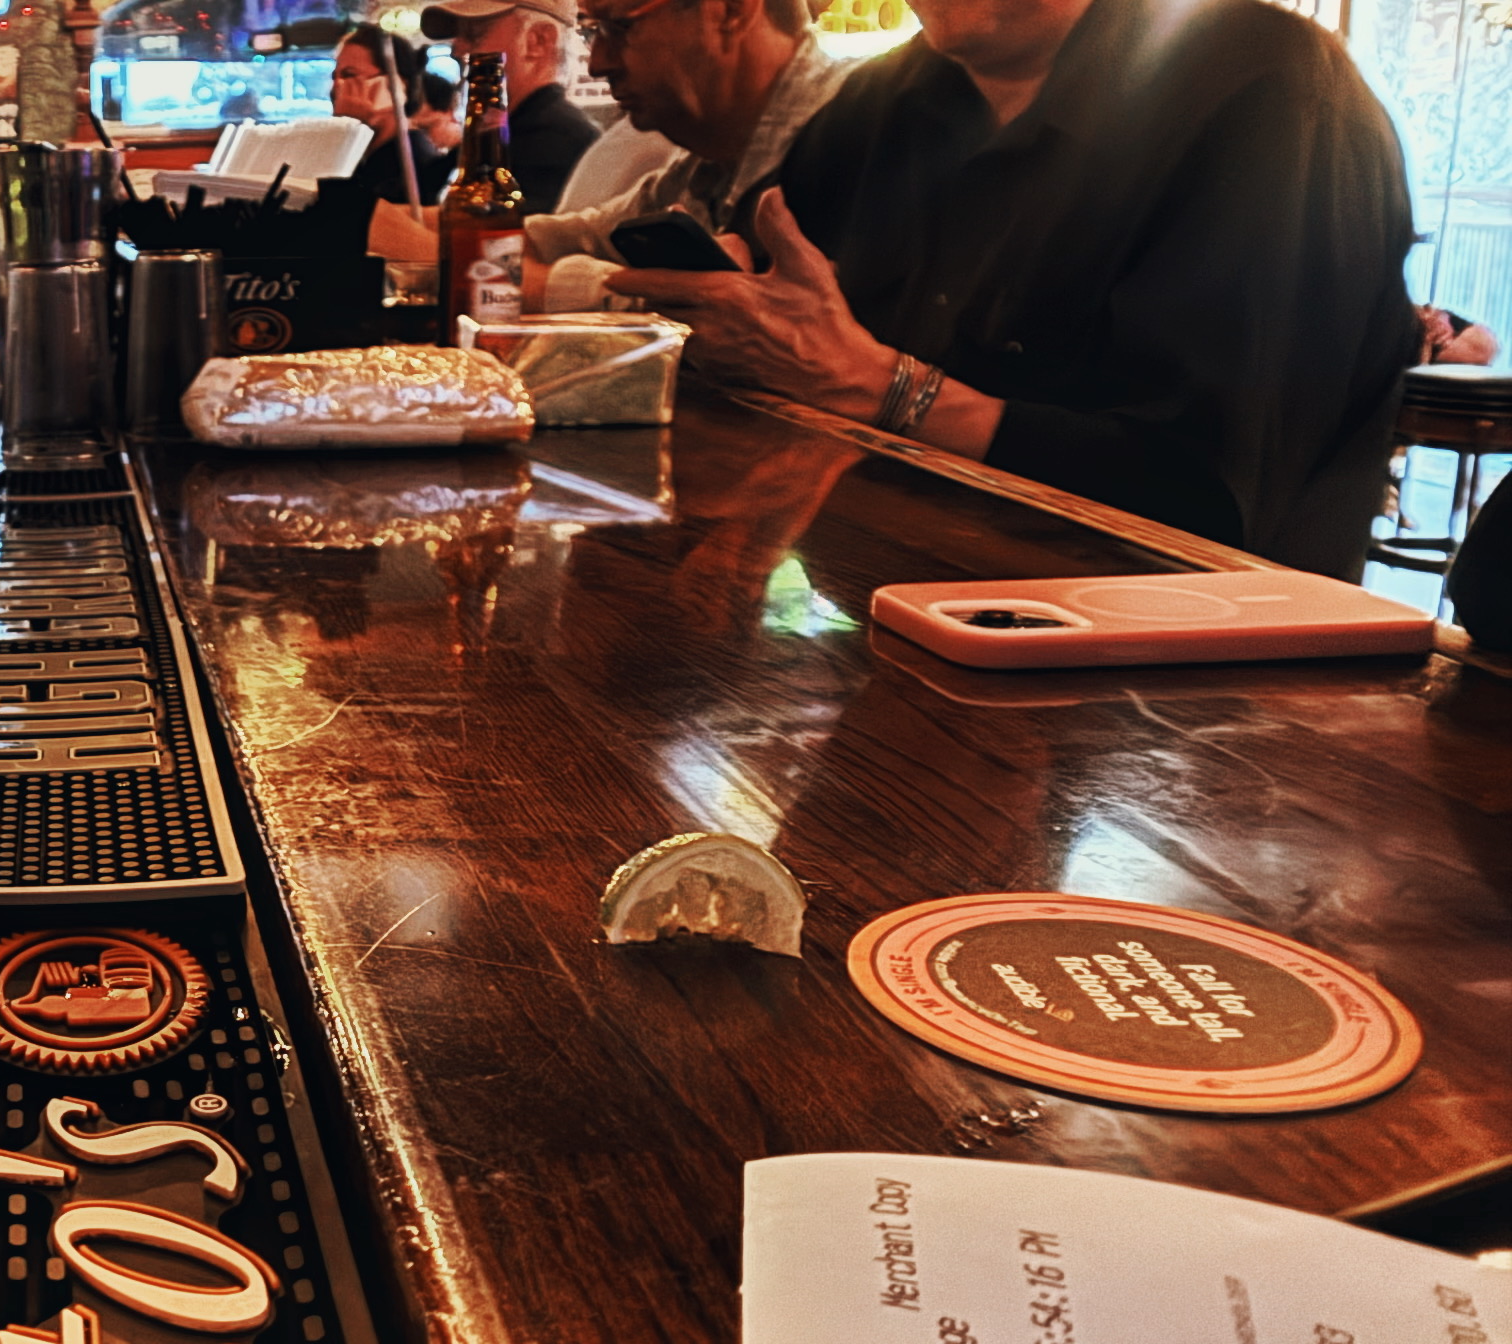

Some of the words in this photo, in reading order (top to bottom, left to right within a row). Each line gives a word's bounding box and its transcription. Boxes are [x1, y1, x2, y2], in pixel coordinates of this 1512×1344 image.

[888, 953, 928, 996] SINGLE
[991, 962, 1049, 1010] audible
[1055, 955, 1140, 1022] fictional
[1091, 954, 1147, 992] dark
[1131, 994, 1190, 1027] and
[1116, 941, 1204, 1010] someone
[1188, 1011, 1244, 1043] tall
[1178, 964, 1236, 992] Fall
[1210, 994, 1256, 1018] for
[868, 1177, 912, 1216] Copy
[873, 1222, 921, 1312] Merchant
[1018, 1228, 1062, 1259] PM
